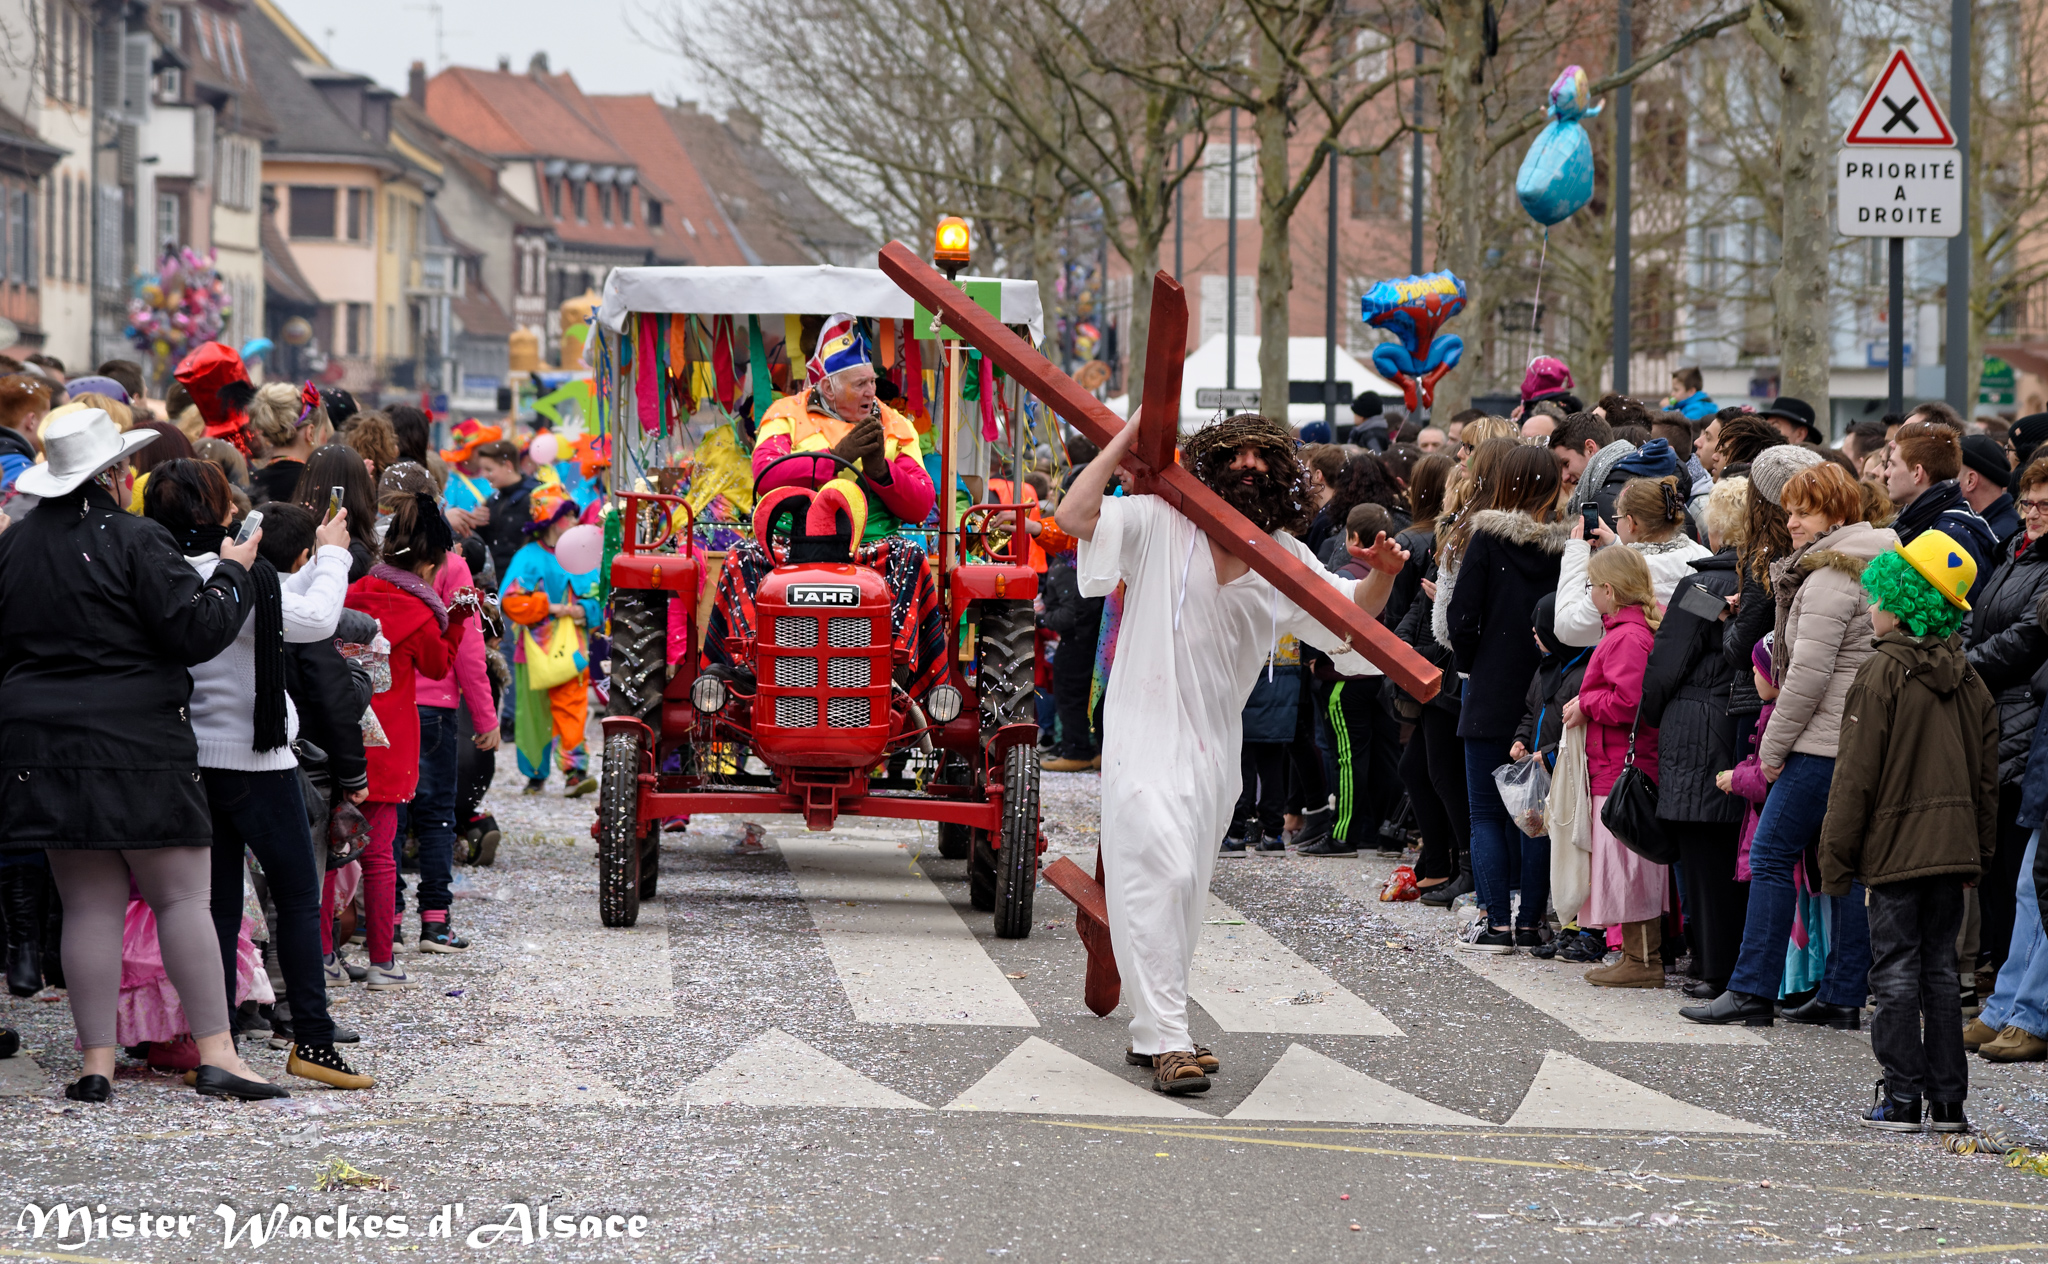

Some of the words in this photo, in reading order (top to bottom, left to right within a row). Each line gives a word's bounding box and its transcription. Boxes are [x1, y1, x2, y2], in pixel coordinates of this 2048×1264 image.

[1846, 160, 1955, 179] PRIORITÉ
[1894, 185, 1907, 201] A
[1858, 206, 1942, 224] DROITE
[793, 587, 854, 603] FAHR
